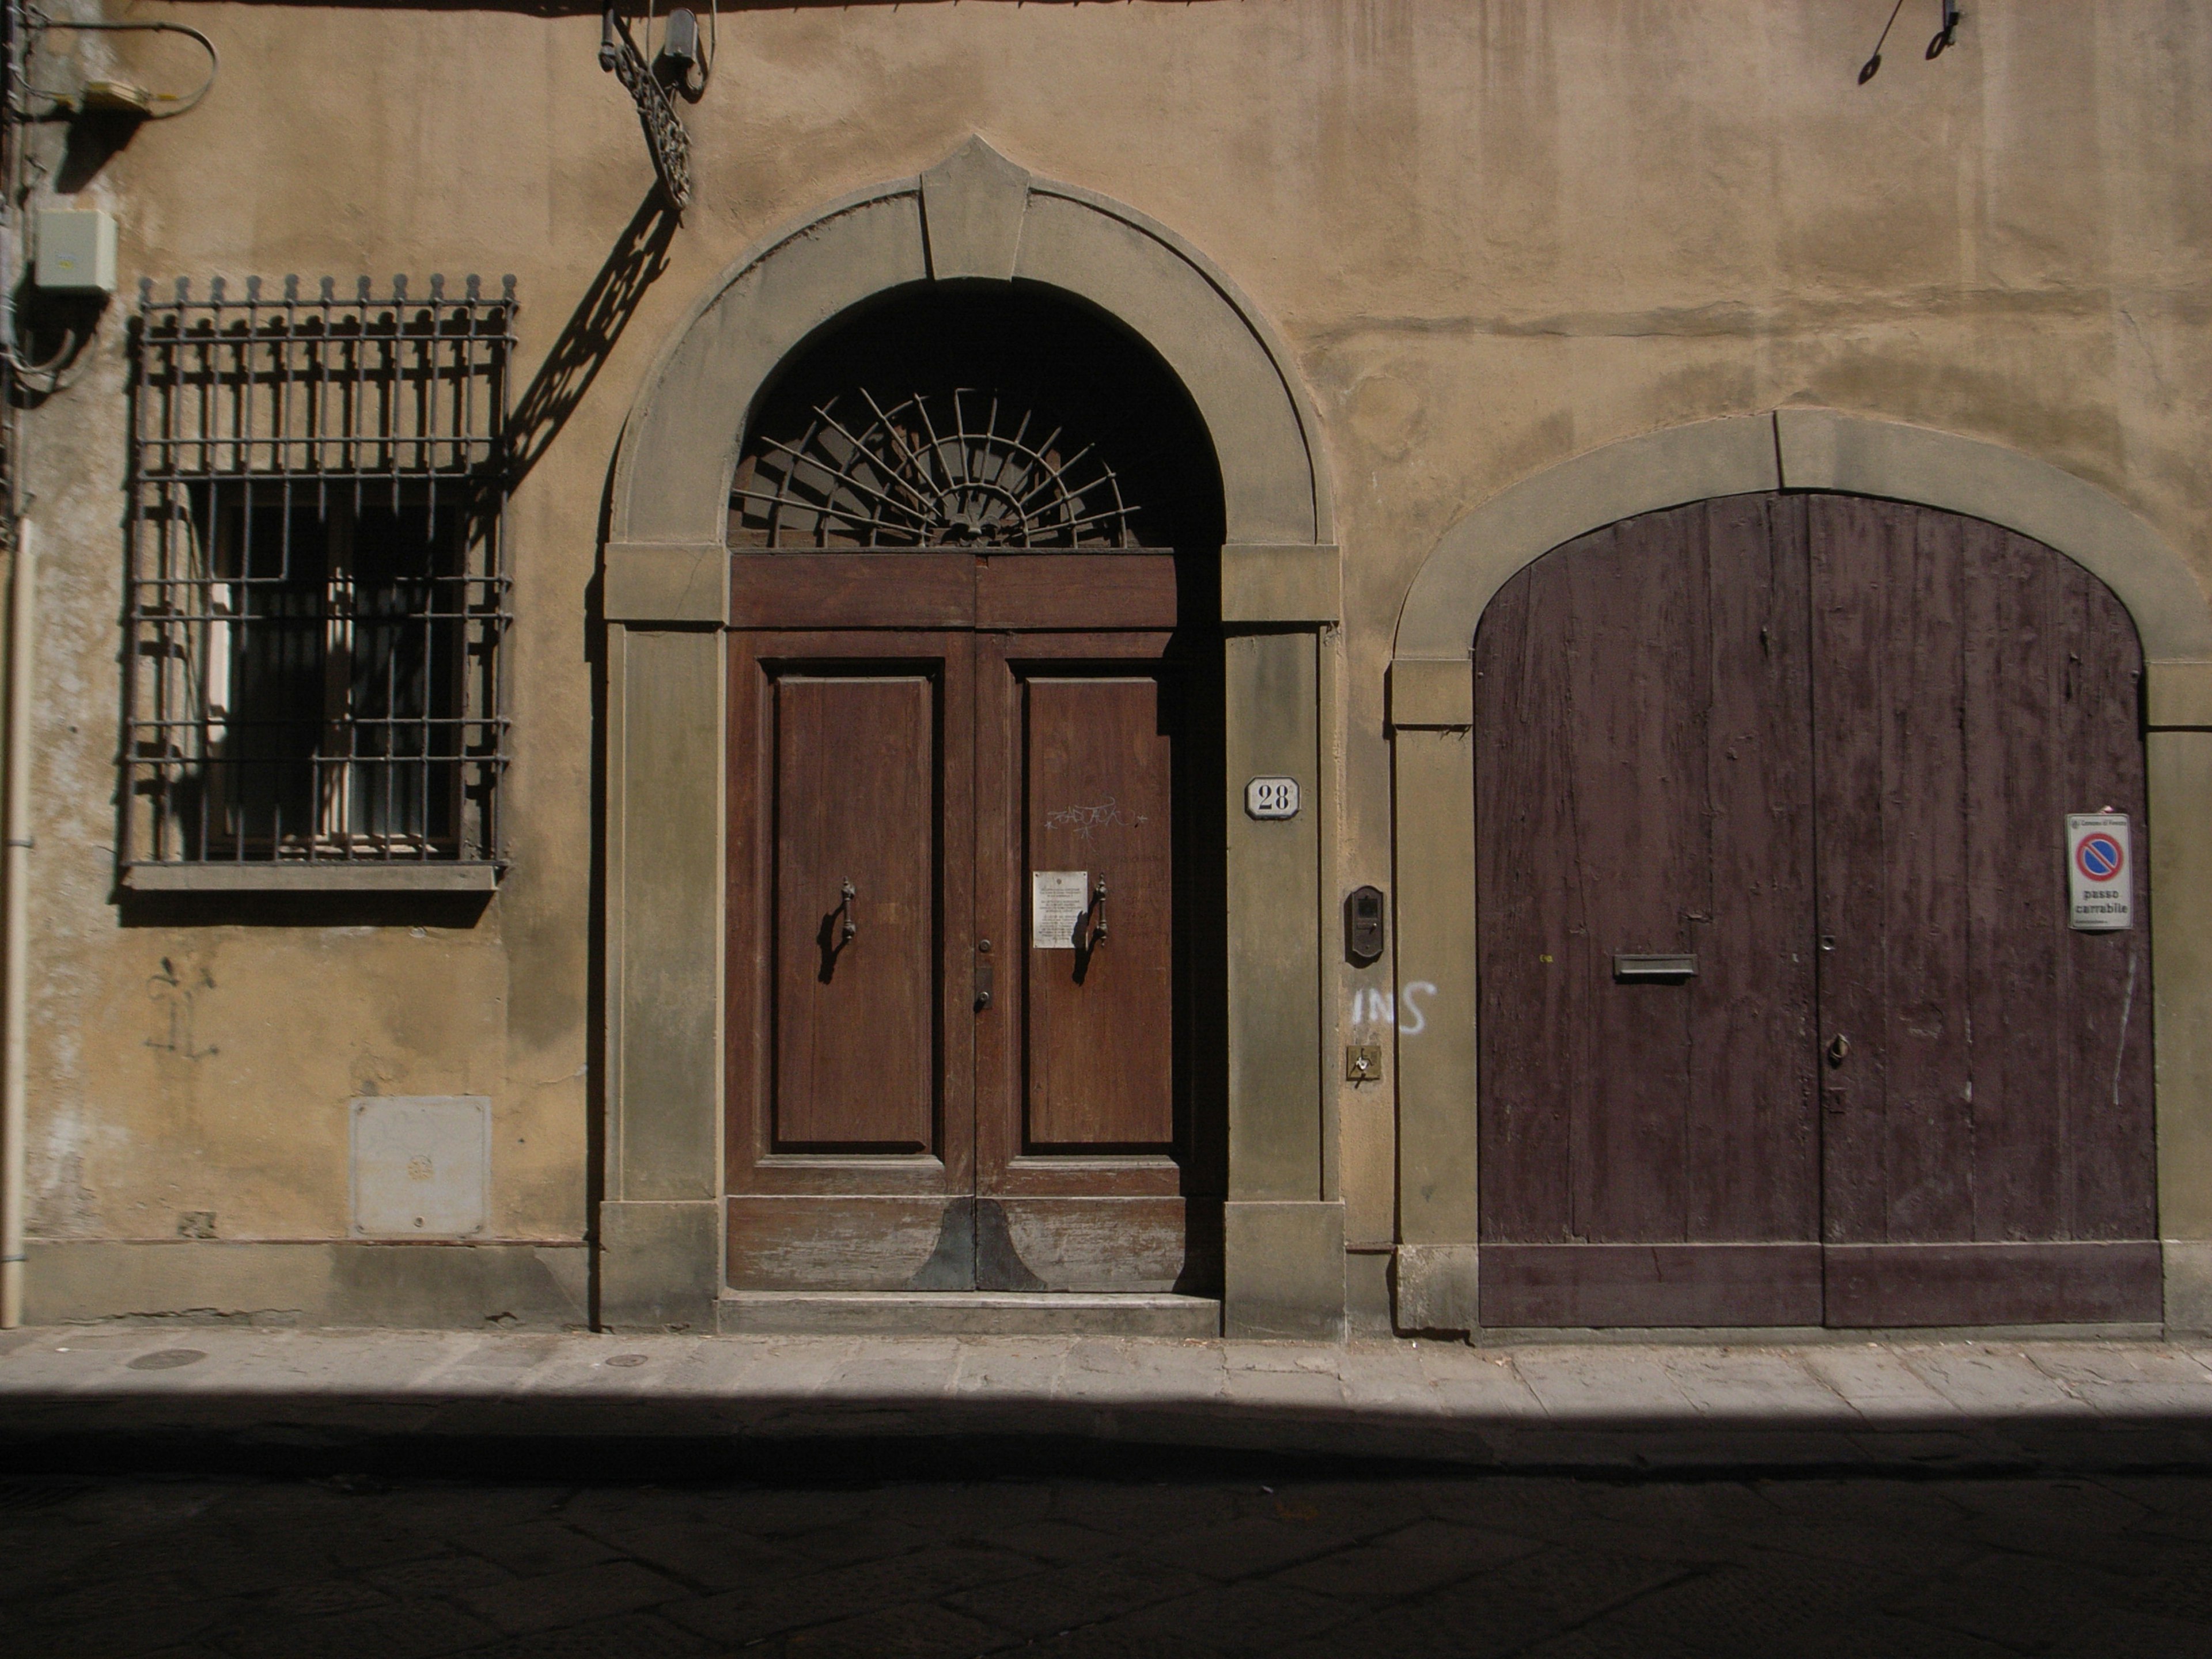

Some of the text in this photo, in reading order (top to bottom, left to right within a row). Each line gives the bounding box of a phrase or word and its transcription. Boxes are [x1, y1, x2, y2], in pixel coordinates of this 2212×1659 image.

[1258, 785, 1289, 810] 28
[2083, 890, 2119, 900] passo
[2075, 903, 2128, 914] carrabile
